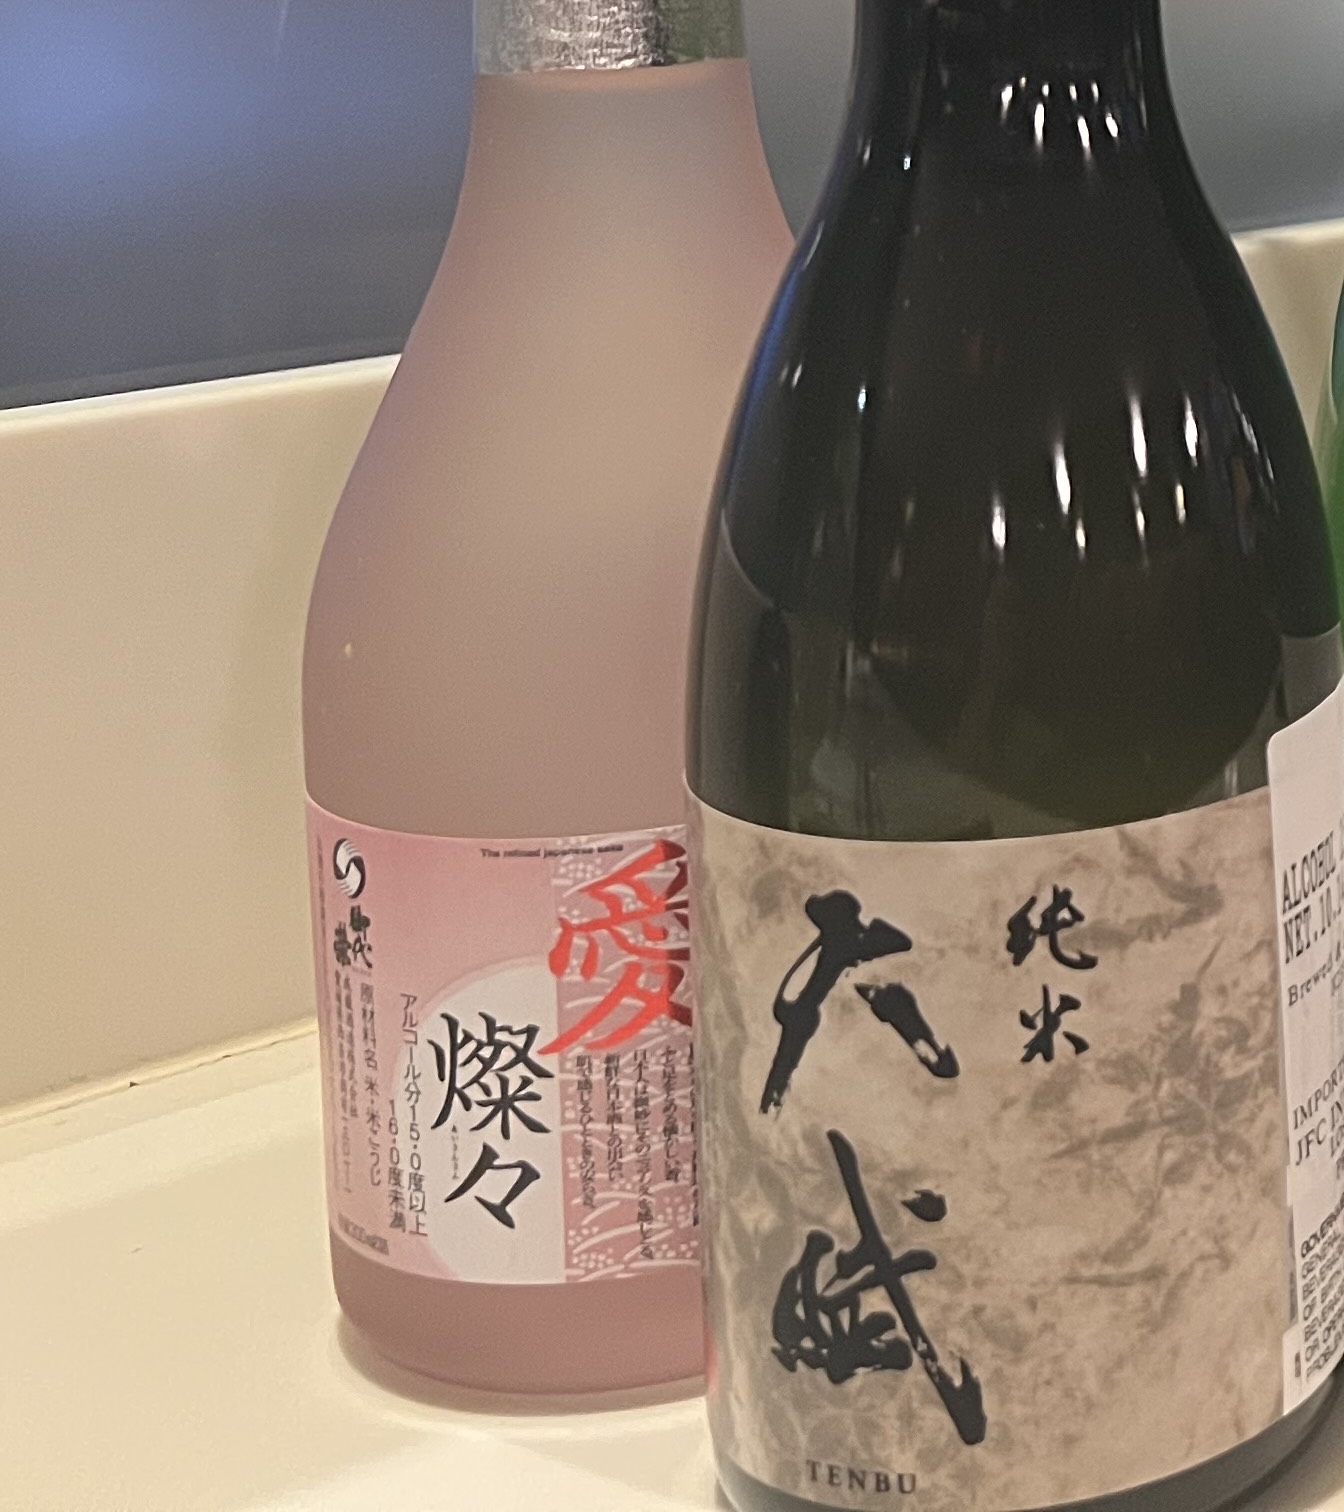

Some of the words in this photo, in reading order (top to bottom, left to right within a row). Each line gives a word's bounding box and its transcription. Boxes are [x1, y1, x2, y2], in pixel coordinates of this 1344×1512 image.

[1282, 830, 1337, 915] ALCOHOL
[537, 838, 694, 1055] 愛
[1006, 884, 1099, 1063] 純米
[1287, 951, 1333, 1007] Brewed
[427, 1011, 555, 1230] 燦々
[1295, 1117, 1327, 1167] JFC
[805, 1458, 917, 1495] TENBU
